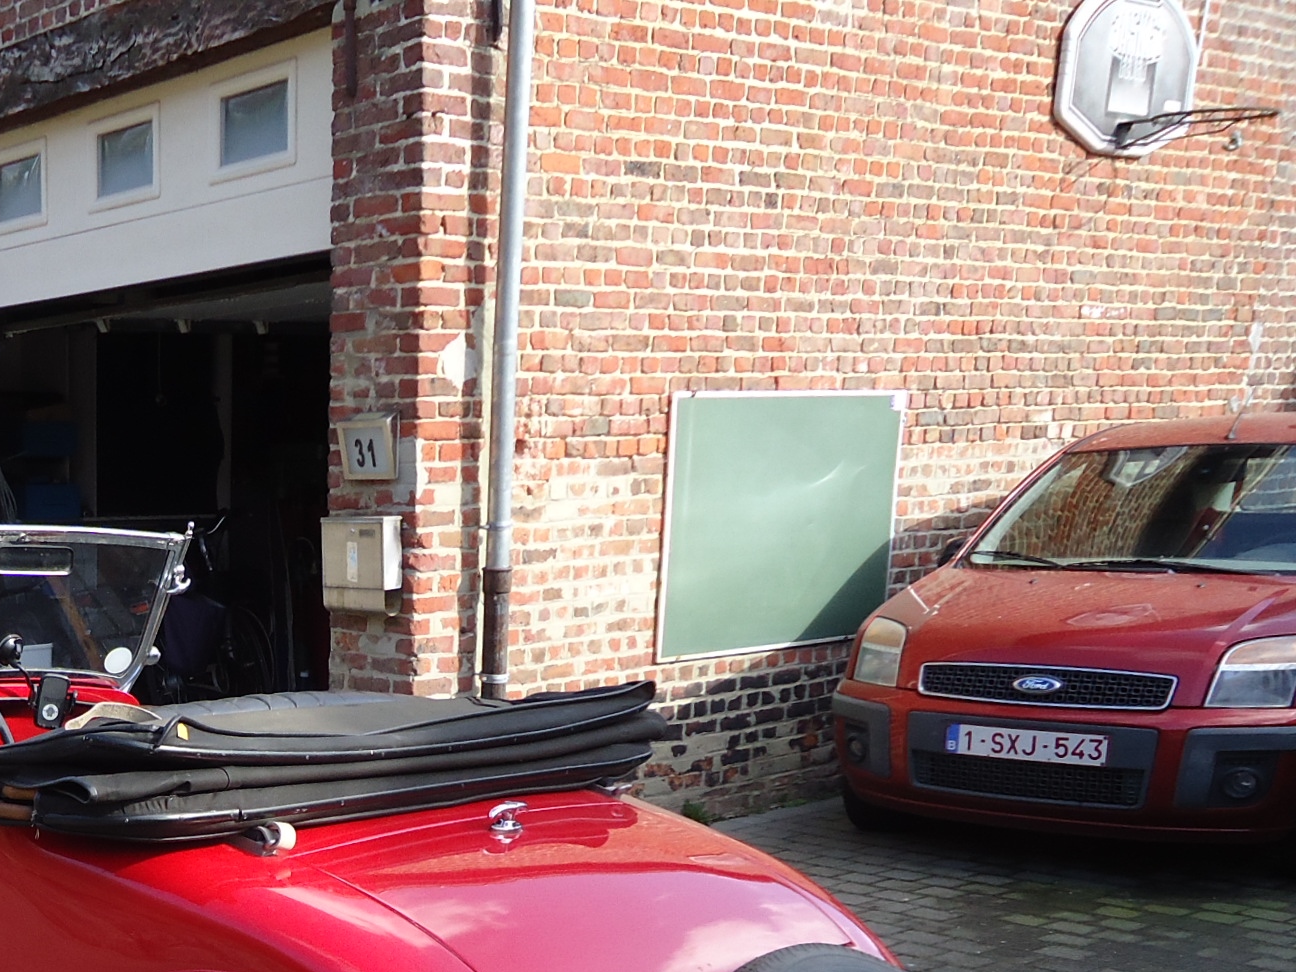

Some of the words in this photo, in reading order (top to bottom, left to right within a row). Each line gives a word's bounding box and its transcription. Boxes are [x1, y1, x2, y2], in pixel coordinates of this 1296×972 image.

[354, 438, 377, 468] 31
[1022, 679, 1050, 690] Ford
[947, 739, 956, 751] B
[963, 730, 1104, 761] 1-SXJ-543
